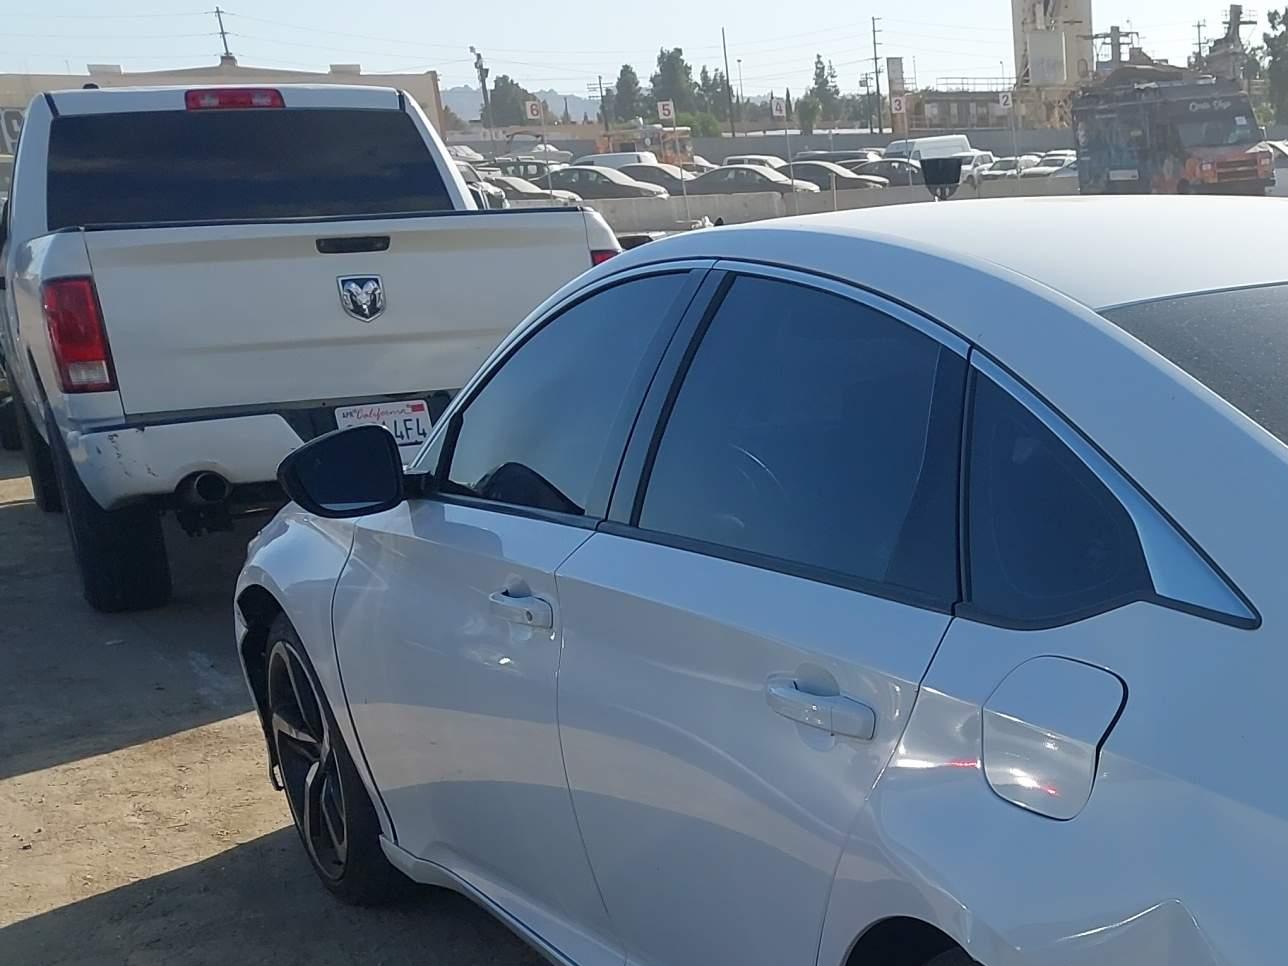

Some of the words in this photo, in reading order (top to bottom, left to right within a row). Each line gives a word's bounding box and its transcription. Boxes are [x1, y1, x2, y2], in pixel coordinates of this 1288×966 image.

[894, 99, 902, 111] 3
[1002, 94, 1009, 106] 2
[662, 103, 671, 117] 5
[775, 102, 783, 114] 4
